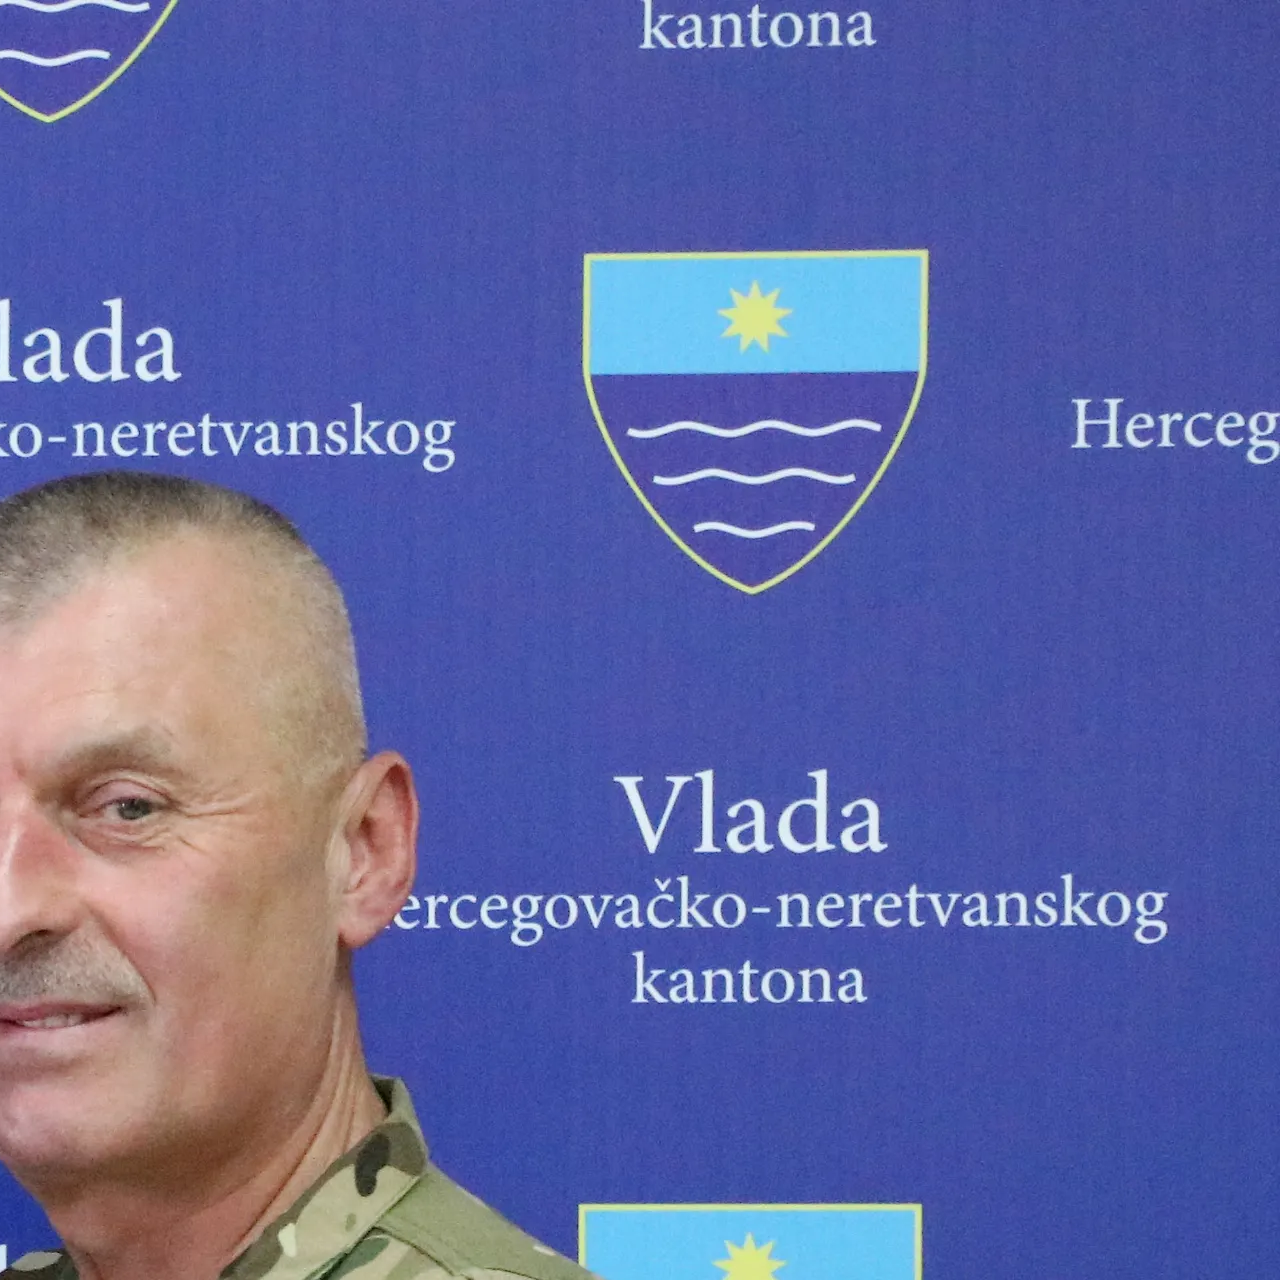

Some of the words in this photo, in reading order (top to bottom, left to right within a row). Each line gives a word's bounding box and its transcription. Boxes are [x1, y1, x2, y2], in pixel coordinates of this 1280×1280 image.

[639, 0, 877, 50] kantona
[1070, 397, 1280, 465] Herceg
[613, 768, 889, 854] Vlada
[383, 874, 1169, 945] ercegovačko-neretvanskog
[631, 950, 868, 1004] kantona
